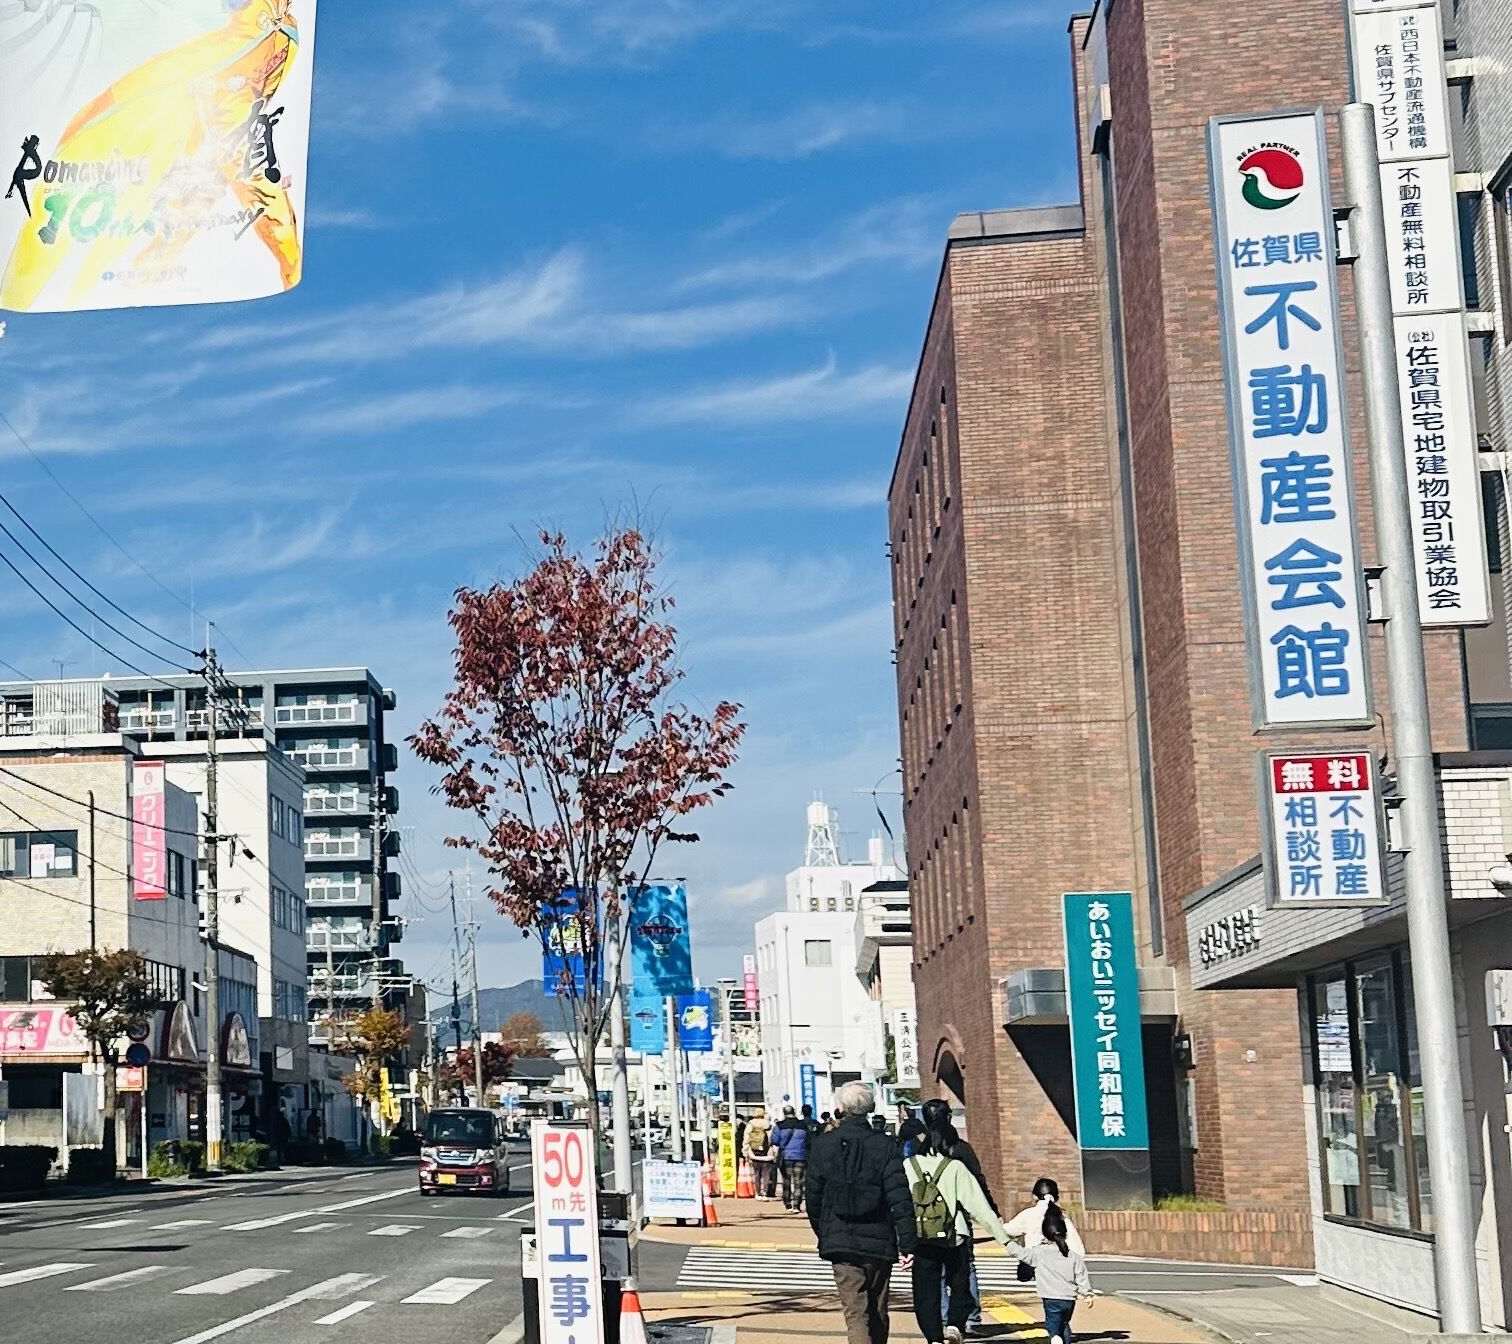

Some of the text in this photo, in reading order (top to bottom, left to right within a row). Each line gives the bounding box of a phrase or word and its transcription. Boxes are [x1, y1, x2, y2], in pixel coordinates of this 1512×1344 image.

[1231, 231, 1323, 268] 佐賀県
[1397, 167, 1428, 304] 不動産無料相談所
[1244, 280, 1350, 699] 不動産会館
[1281, 759, 1361, 791] 無料
[1285, 797, 1321, 897] 相談所
[1329, 795, 1368, 895] 不動産
[1088, 902, 1126, 1137] あいおいニッセイ同和損保
[544, 1132, 582, 1187] 50
